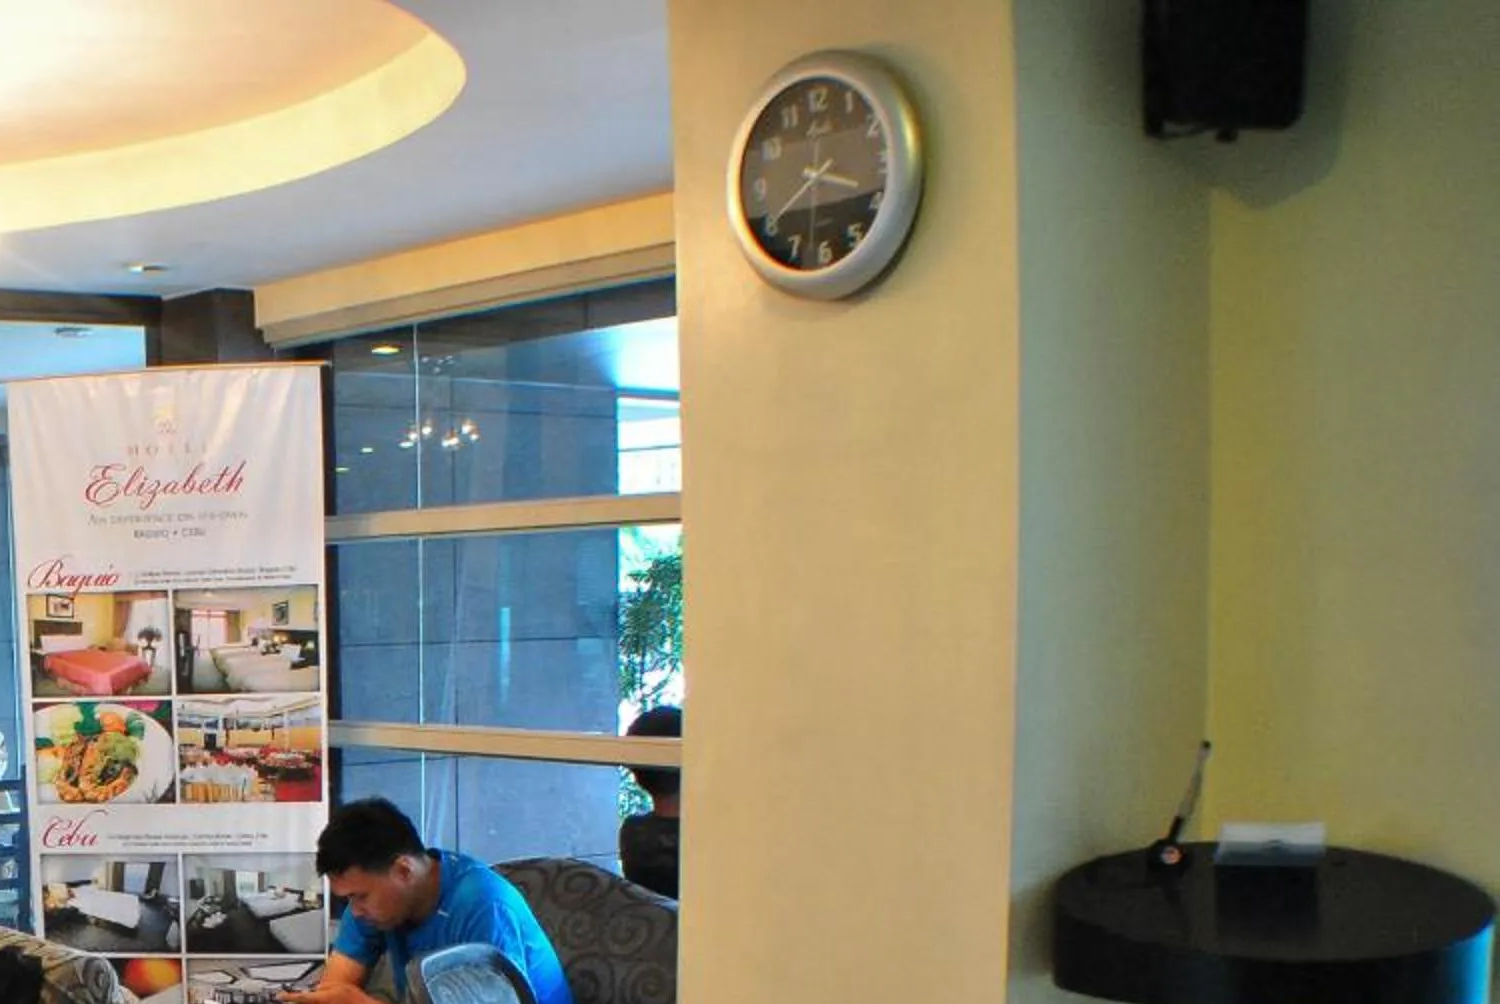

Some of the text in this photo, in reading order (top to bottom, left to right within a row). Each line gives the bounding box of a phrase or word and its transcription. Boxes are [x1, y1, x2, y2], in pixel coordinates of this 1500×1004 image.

[808, 85, 829, 113] 12
[844, 90, 854, 113] 1
[781, 104, 799, 129] 11
[866, 113, 881, 138] 2
[762, 136, 782, 161] 10
[754, 177, 767, 201] 9
[867, 191, 883, 211] 4
[764, 213, 779, 237] 8
[847, 222, 864, 248] 5
[786, 234, 800, 261] 7
[816, 240, 833, 264] 6
[84, 460, 247, 510] Elizabeth
[41, 809, 108, 849] Cebu
